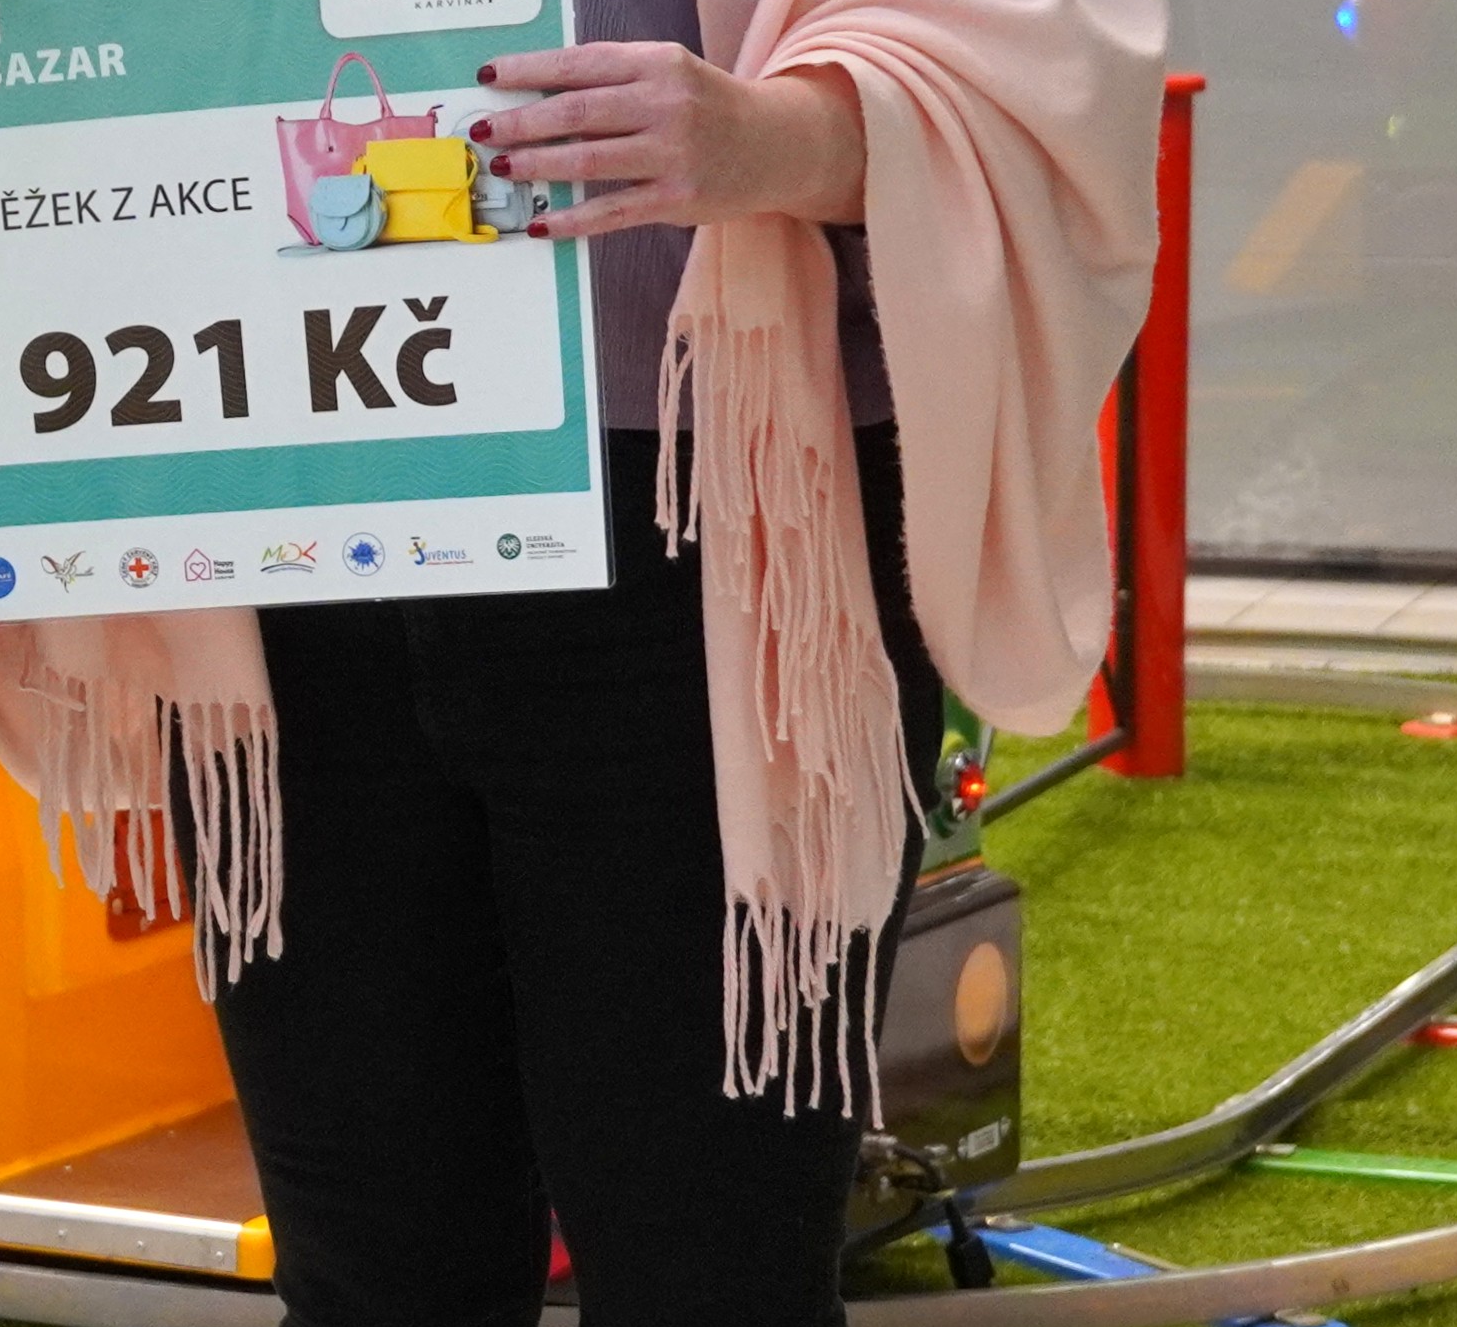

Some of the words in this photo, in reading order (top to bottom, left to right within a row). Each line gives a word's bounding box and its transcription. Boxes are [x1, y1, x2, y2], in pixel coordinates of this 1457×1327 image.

[111, 186, 137, 221] Z
[149, 176, 253, 219] AKCE
[19, 317, 253, 435] 921
[301, 293, 460, 415] Kč
